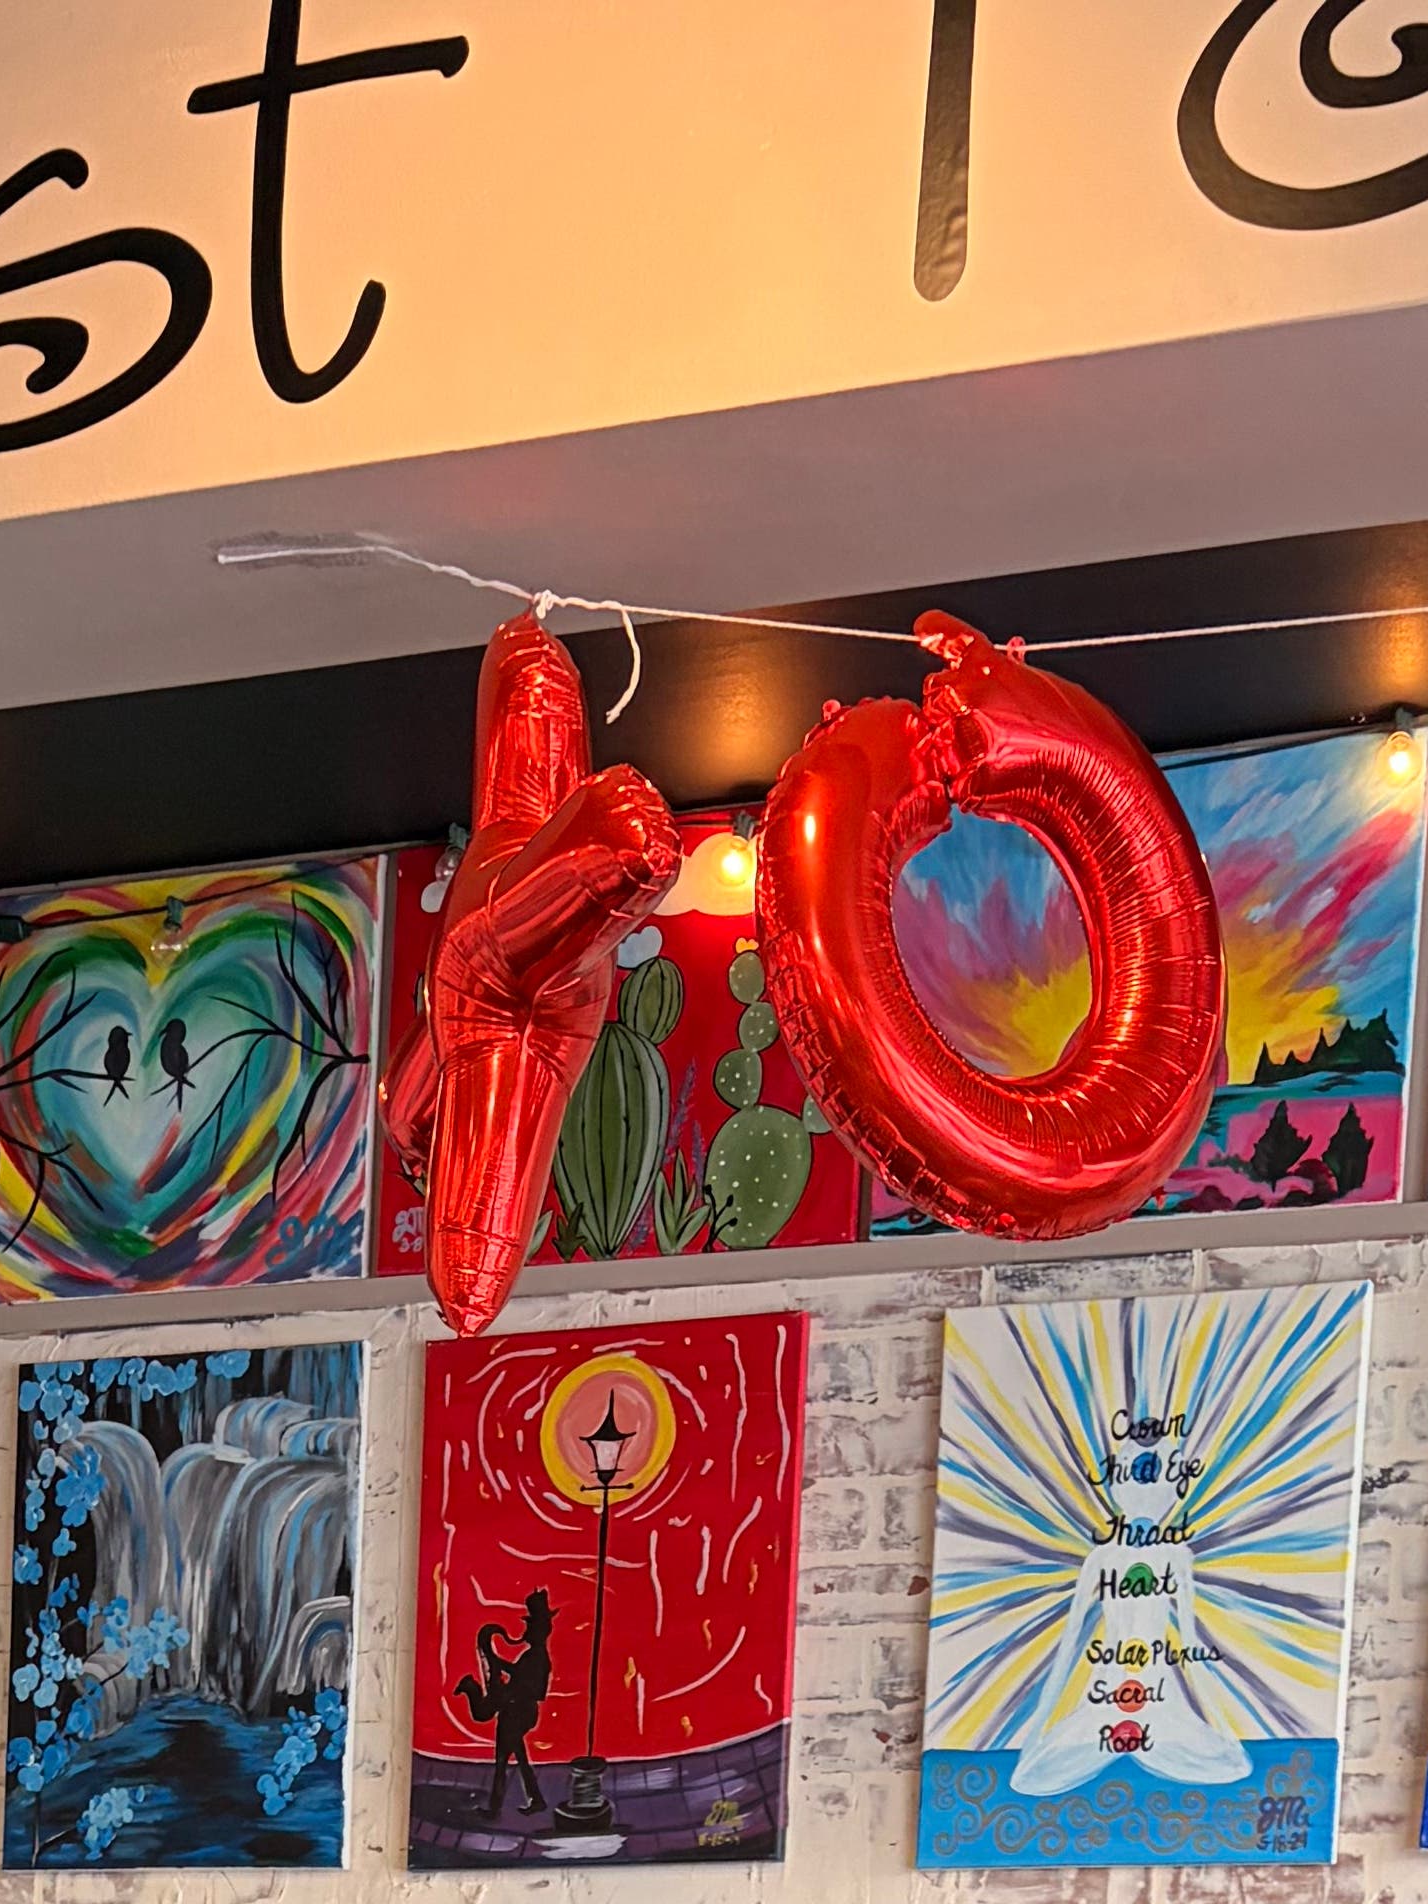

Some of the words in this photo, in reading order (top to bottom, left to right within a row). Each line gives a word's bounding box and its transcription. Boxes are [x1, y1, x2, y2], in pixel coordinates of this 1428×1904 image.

[1111, 1409, 1195, 1441] Crown
[1088, 1451, 1158, 1486] Third
[1165, 1450, 1206, 1500] Eye
[1092, 1511, 1195, 1546] Throat
[1099, 1562, 1178, 1600] Heart
[1086, 1639, 1149, 1667] Solar
[1151, 1639, 1224, 1668] Plexus
[1087, 1678, 1165, 1705] Sacral
[1099, 1723, 1154, 1753] Root
